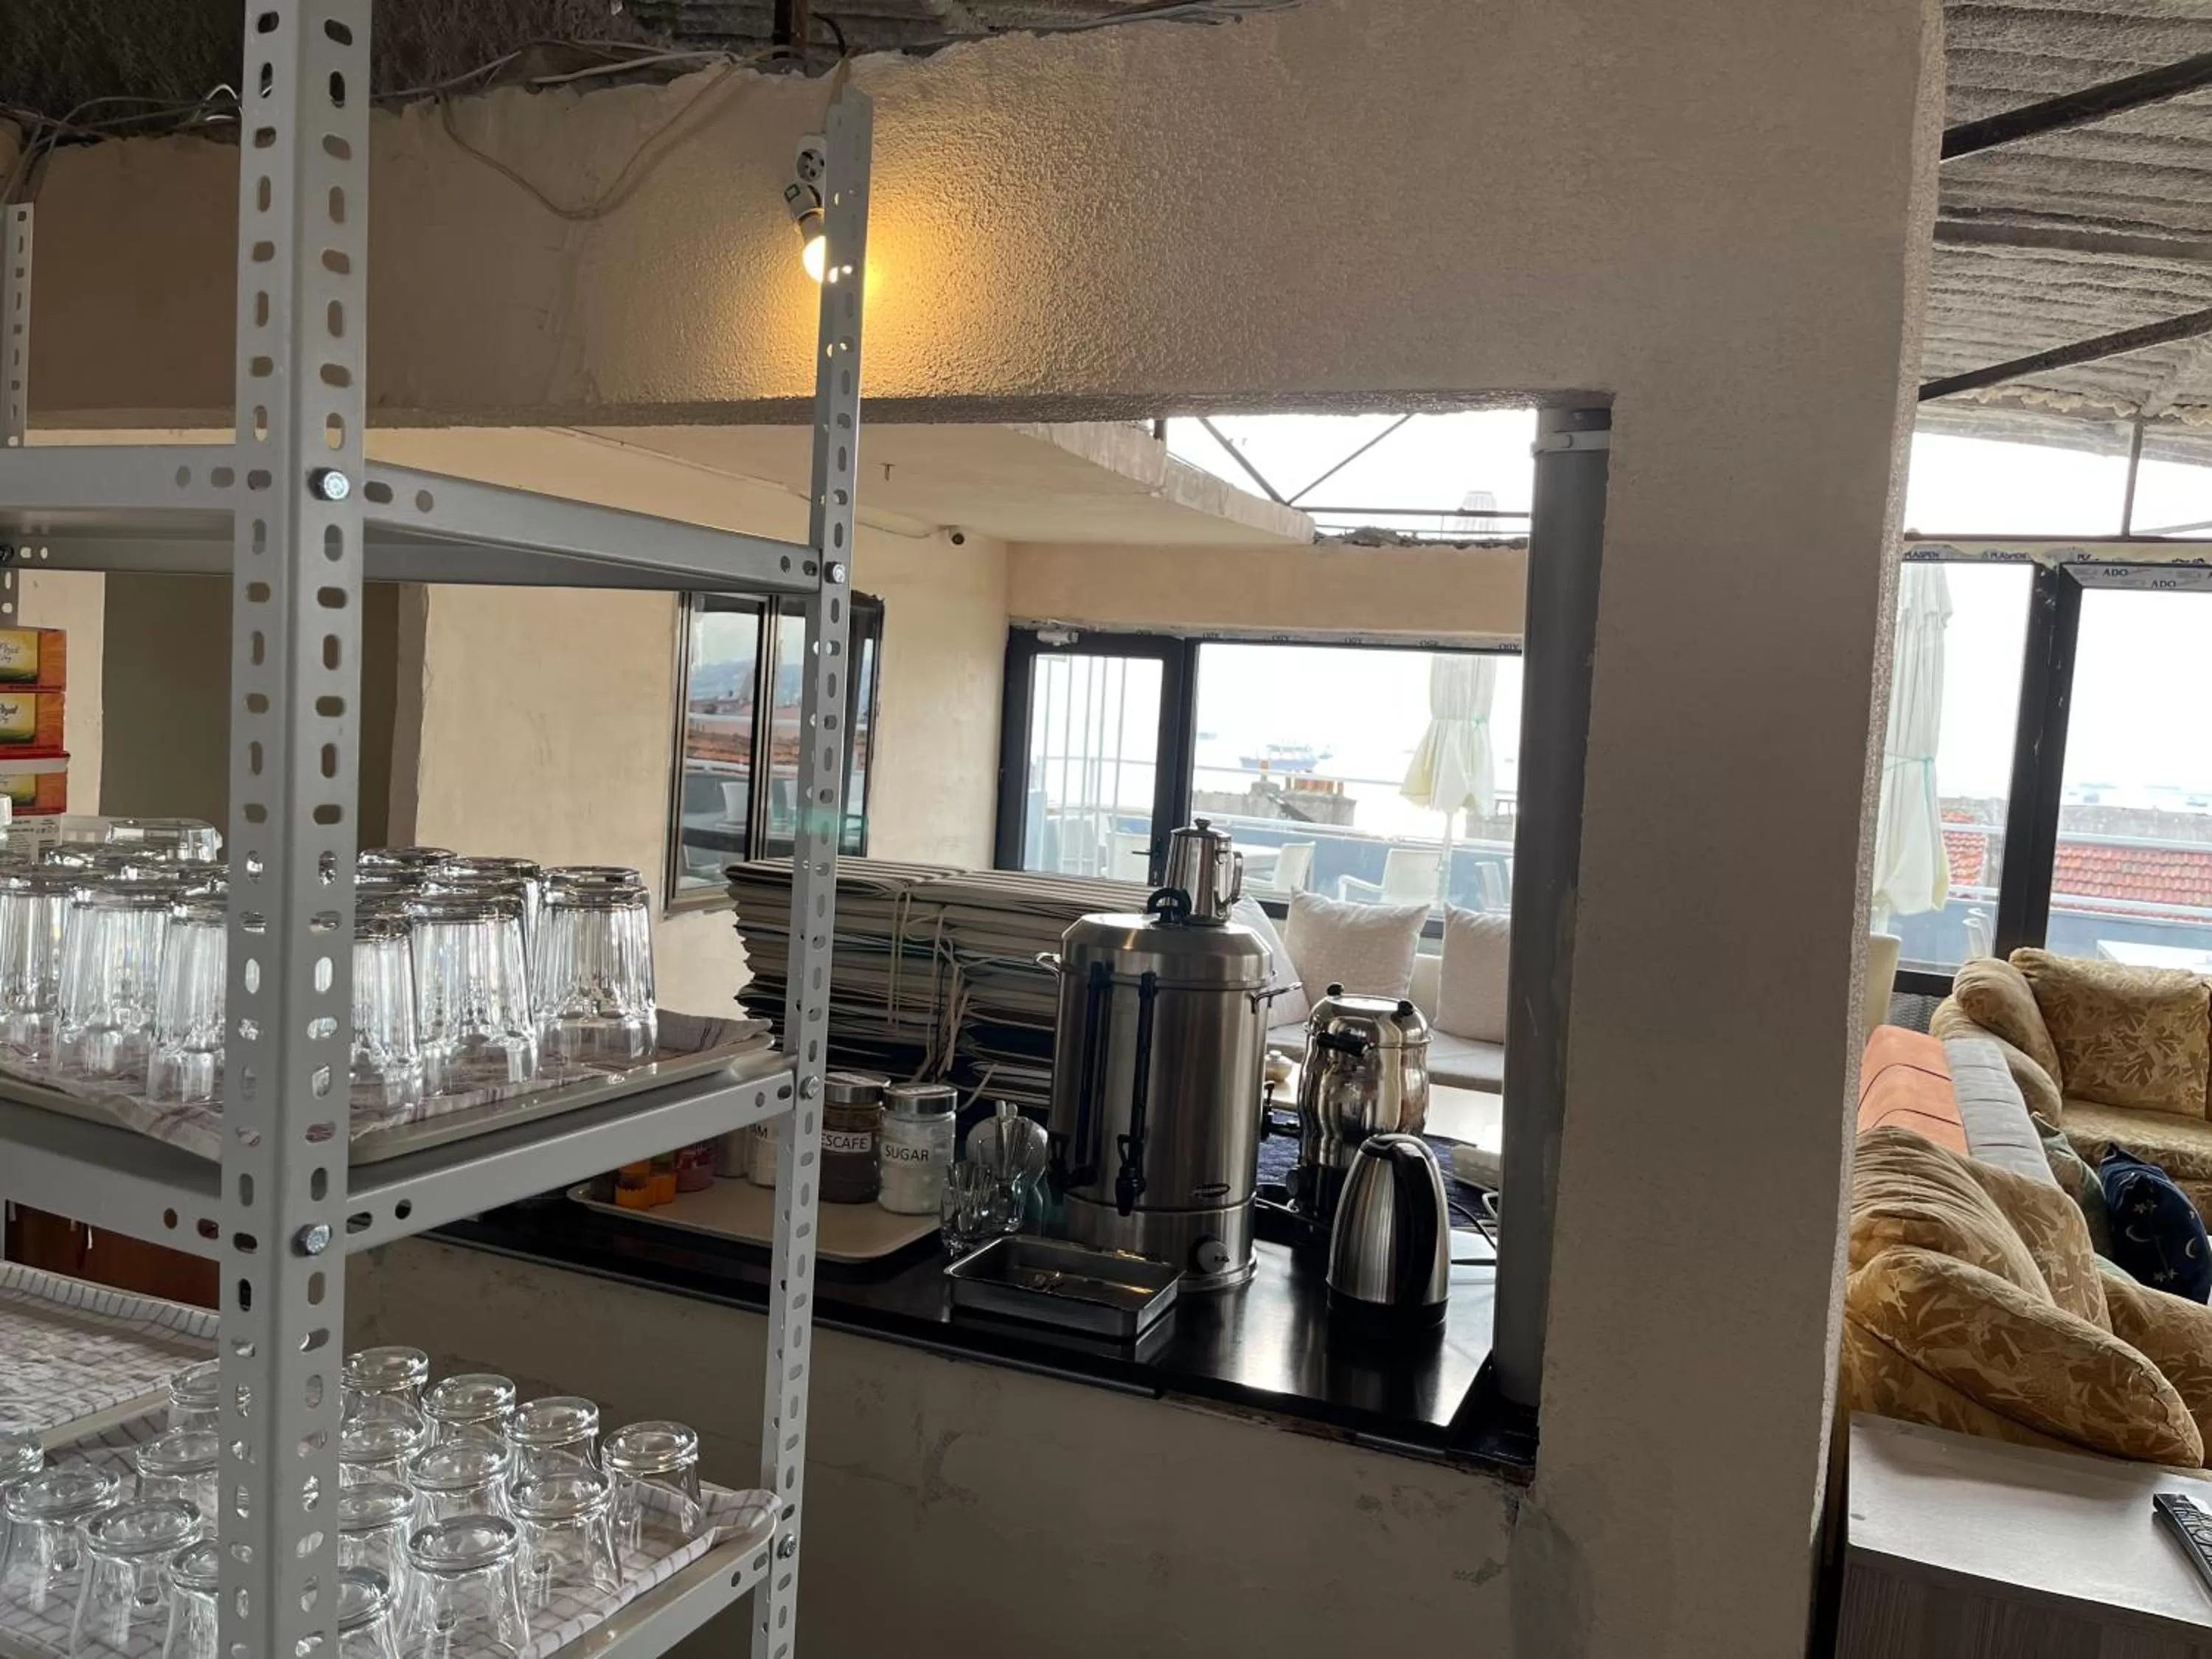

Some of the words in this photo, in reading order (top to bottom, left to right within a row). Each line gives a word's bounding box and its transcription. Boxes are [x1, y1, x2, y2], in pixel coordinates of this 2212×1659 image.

[2102, 567, 2129, 577] ADO
[2151, 579, 2177, 588] ADO
[886, 1145, 929, 1162] SUGAR
